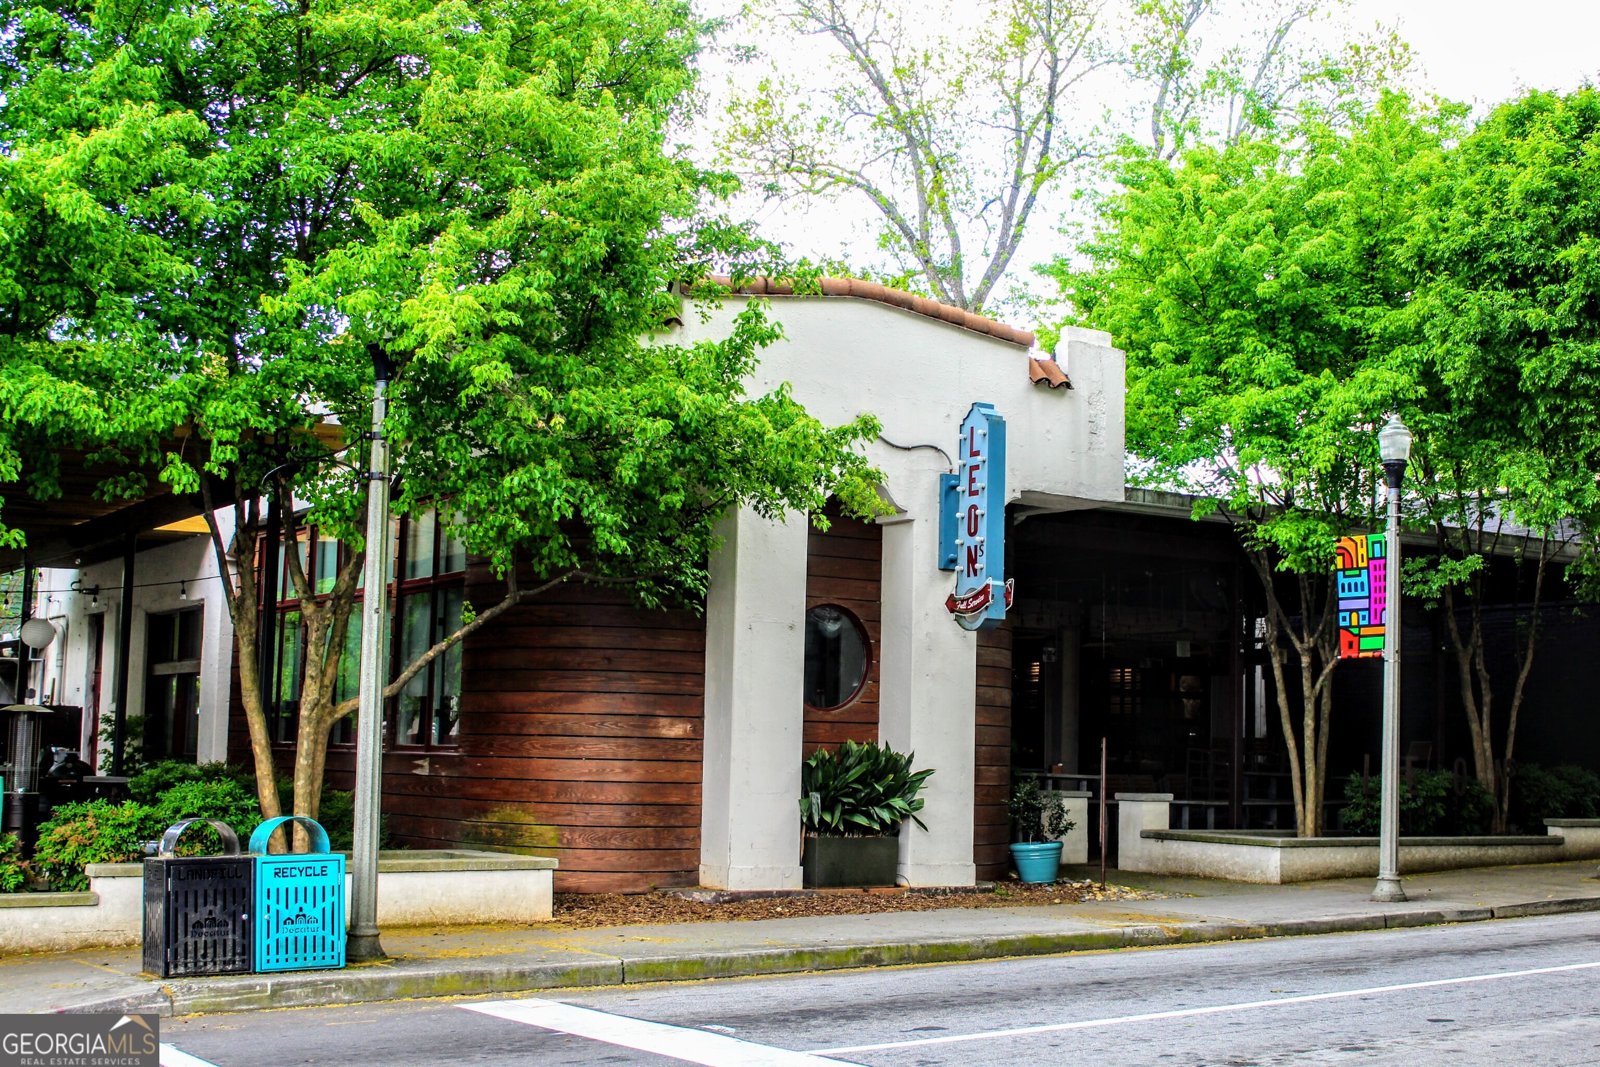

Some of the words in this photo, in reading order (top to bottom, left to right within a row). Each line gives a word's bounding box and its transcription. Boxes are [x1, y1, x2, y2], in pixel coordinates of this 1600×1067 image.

[178, 868, 243, 881] LANDFILL
[273, 865, 329, 879] RECYCLE
[190, 927, 230, 938] Decatur
[281, 925, 321, 935] Decatur
